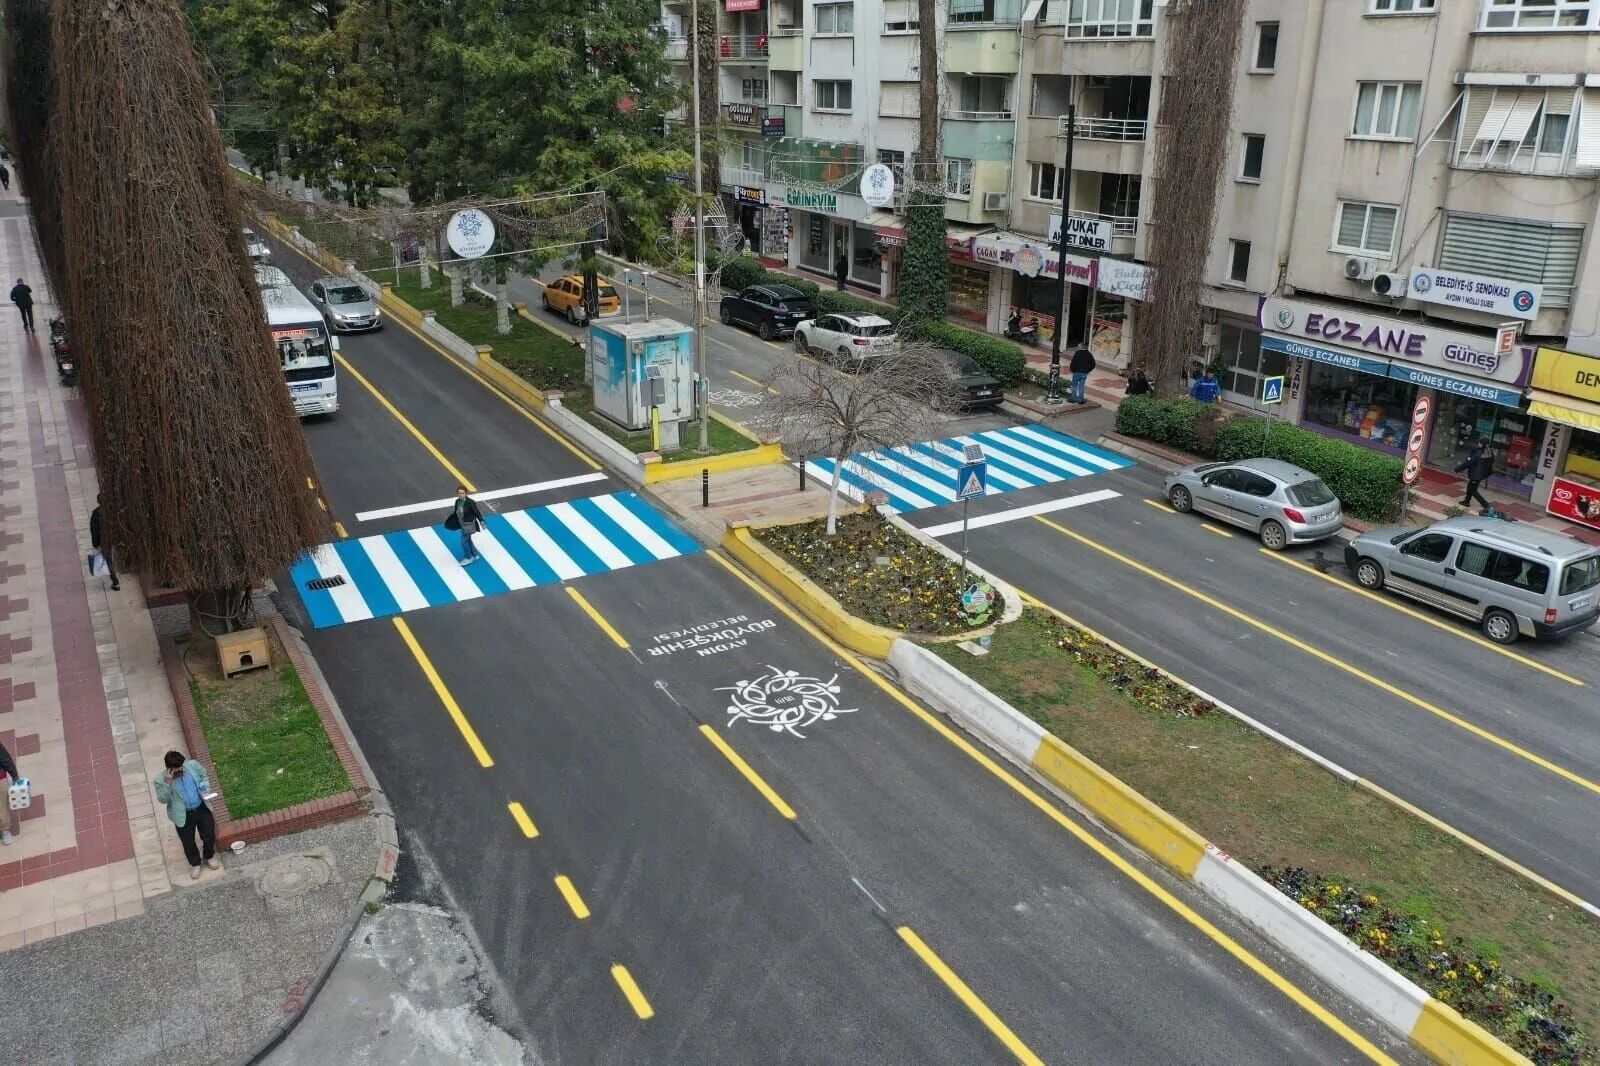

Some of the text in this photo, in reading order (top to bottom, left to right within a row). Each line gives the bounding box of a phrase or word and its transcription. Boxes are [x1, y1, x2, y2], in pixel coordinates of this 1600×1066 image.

[1053, 231, 1077, 243] AHET
[1060, 218, 1099, 234] VUKAT
[1114, 268, 1147, 279] Bulu
[1475, 282, 1511, 298] SENDİKASI
[1304, 313, 1499, 374] ECZANE Güneş
[1500, 333, 1513, 353] E
[1286, 343, 1361, 368] GÜNEŞ ECZANESİ
[1409, 370, 1499, 400] GÜNEŞ ECZANESİ
[1543, 423, 1561, 469] ZANE
[646, 619, 777, 657] BÜYÜKŞEHİR
[653, 614, 749, 643] BELEDİYESİ
[695, 638, 749, 657] AYDIN
